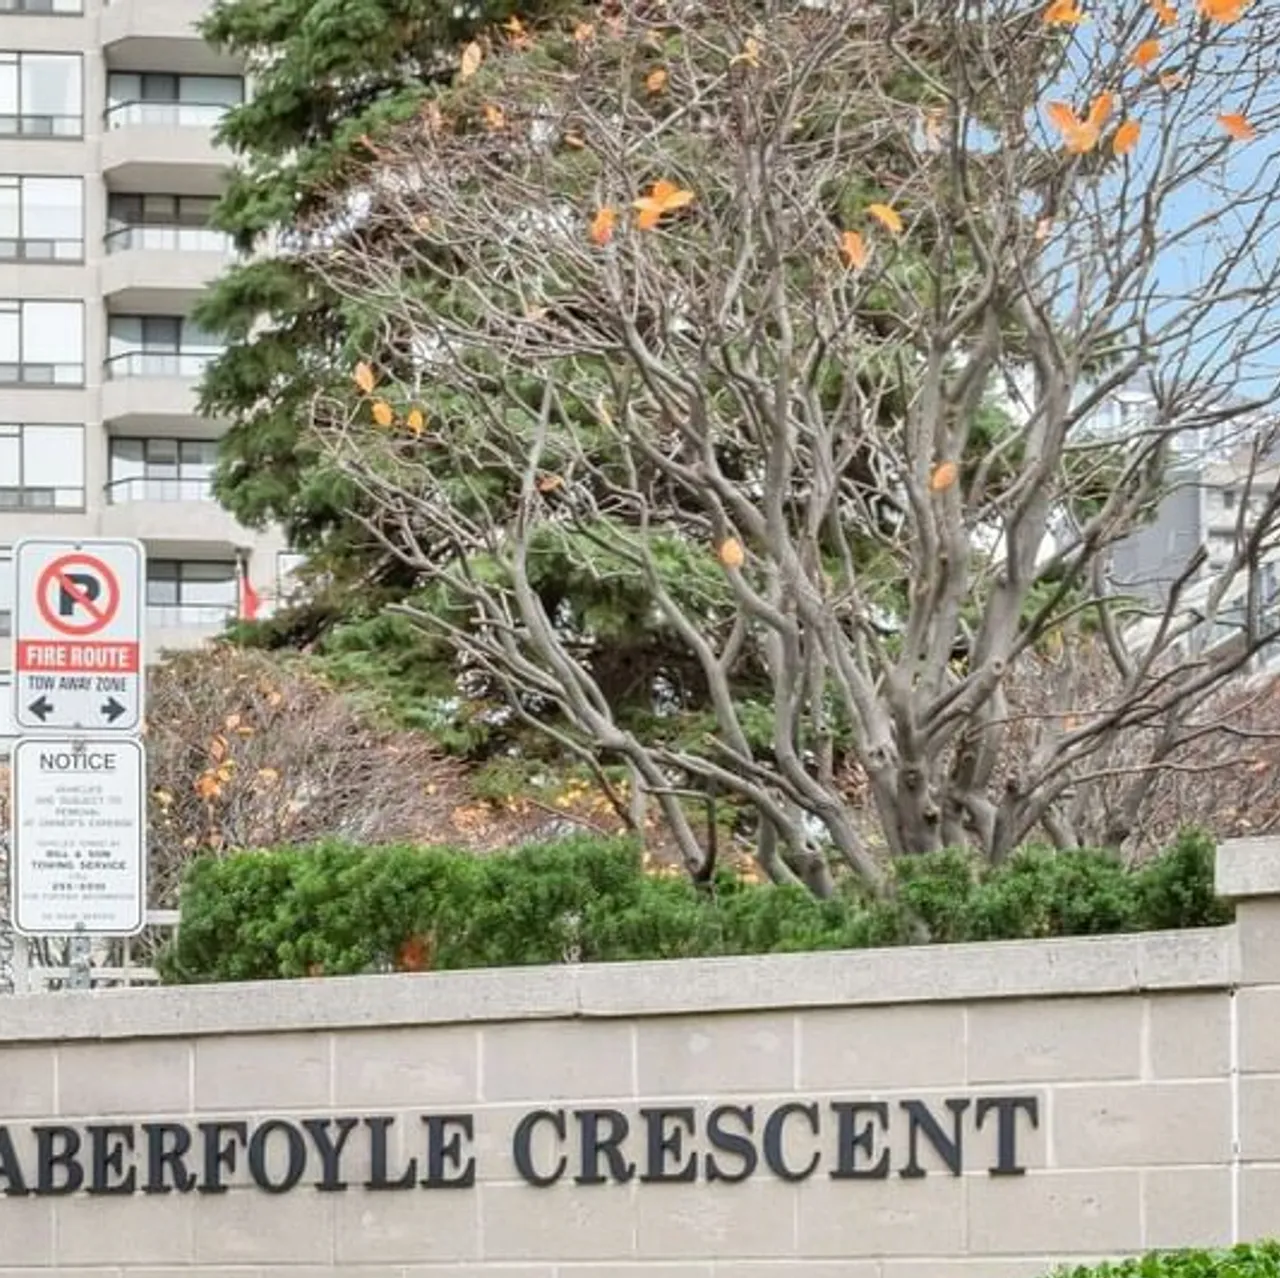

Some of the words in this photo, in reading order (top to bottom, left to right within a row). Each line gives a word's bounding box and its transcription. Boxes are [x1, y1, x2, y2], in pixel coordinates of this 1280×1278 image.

[27, 645, 66, 666] FIRE
[71, 646, 130, 667] ROUTE
[28, 676, 55, 690] TOW
[58, 676, 91, 691] AWAY
[96, 677, 126, 692] ZONE
[39, 753, 117, 770] NOTICE
[80, 860, 127, 871] SERVICE
[512, 1096, 1039, 1187] CRESCENT
